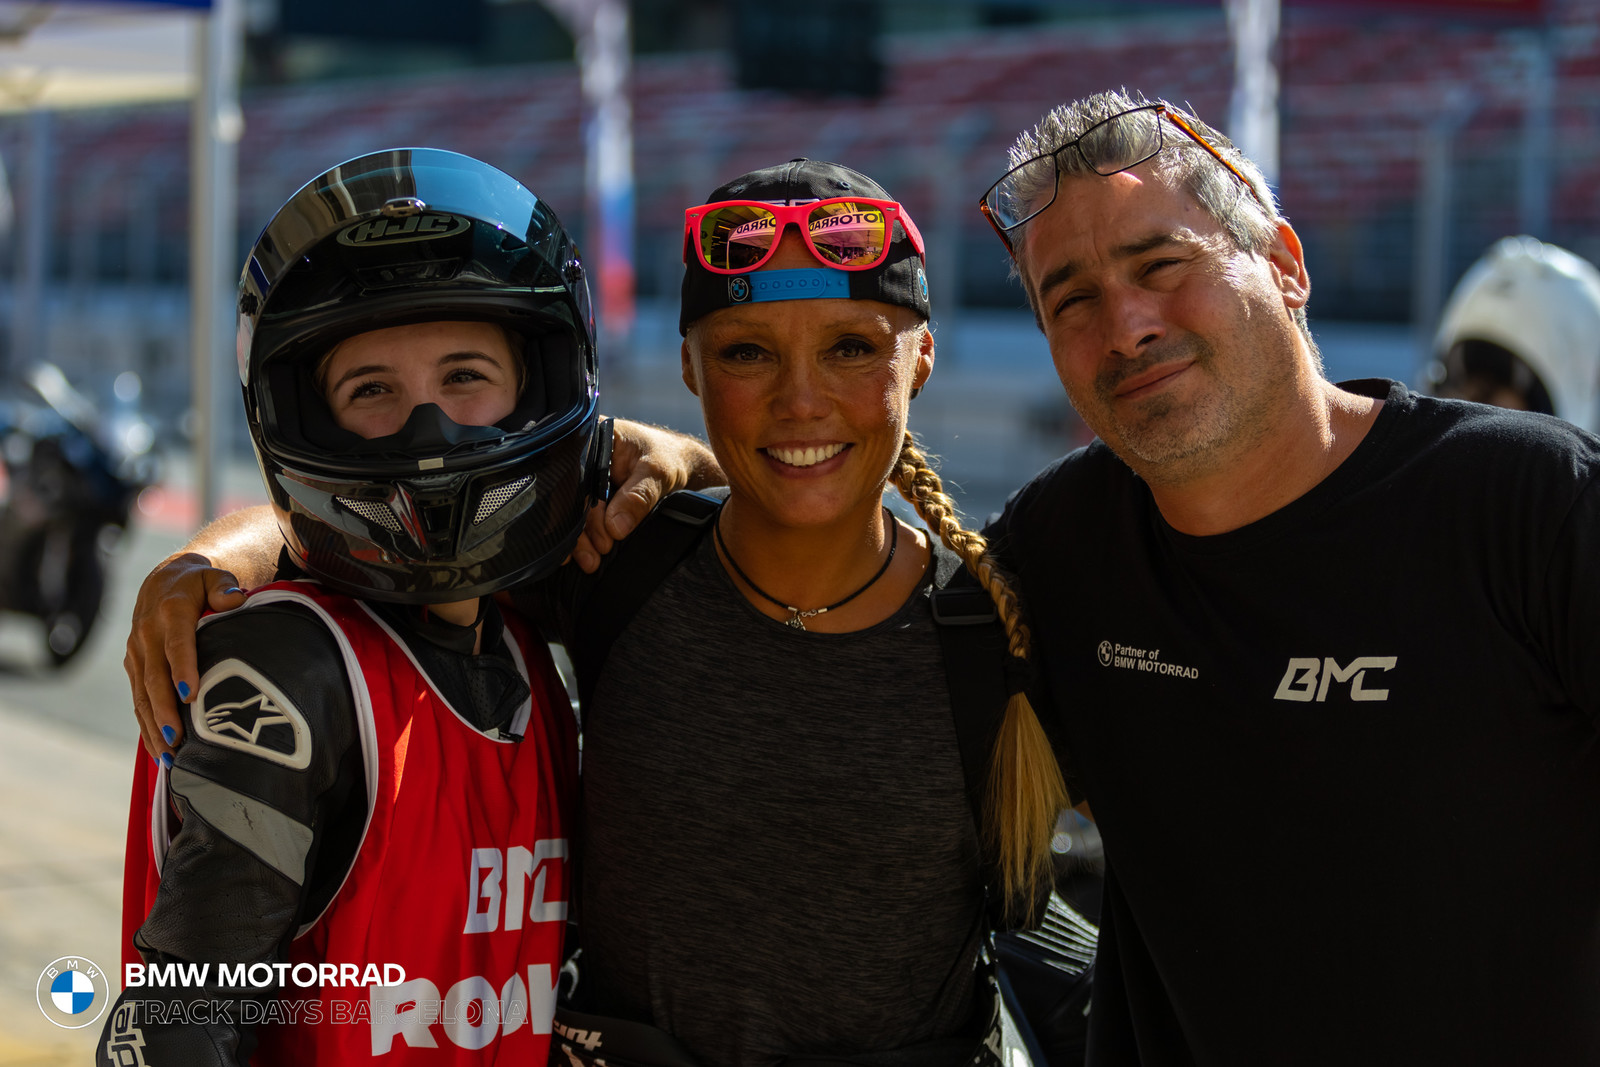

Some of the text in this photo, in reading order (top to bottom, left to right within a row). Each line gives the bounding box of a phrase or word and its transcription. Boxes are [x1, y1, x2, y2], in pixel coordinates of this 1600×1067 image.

[354, 216, 451, 243] HJC
[1115, 644, 1146, 658] Partner
[1149, 650, 1160, 660] of
[1115, 656, 1199, 679] BMW MOTORRAD
[1273, 656, 1399, 702] BMC
